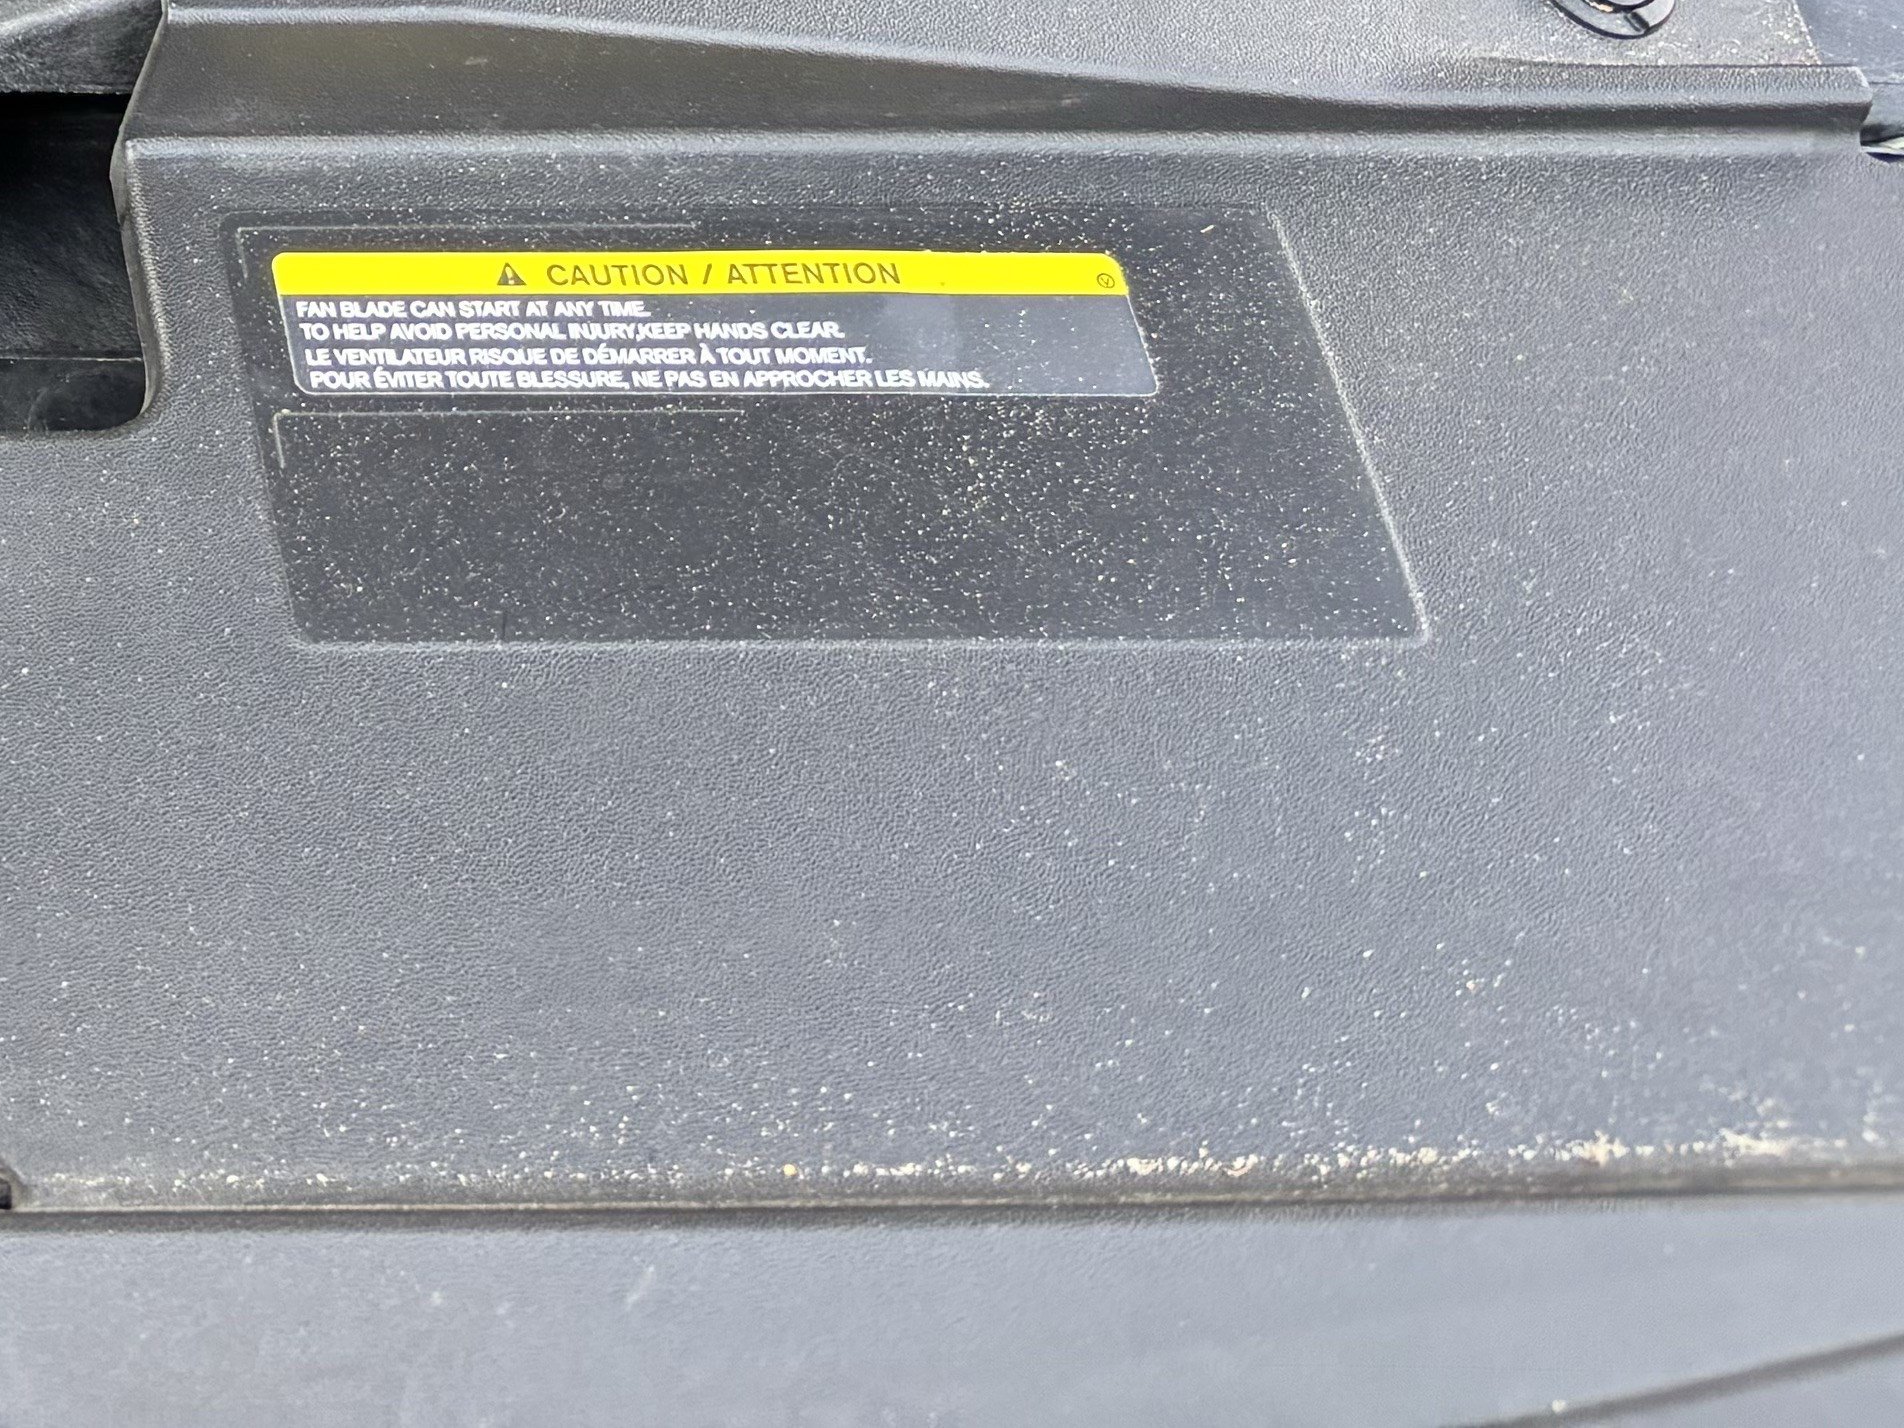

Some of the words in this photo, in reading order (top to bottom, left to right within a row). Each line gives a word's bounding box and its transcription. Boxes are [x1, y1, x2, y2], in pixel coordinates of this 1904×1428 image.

[546, 264, 689, 286] CAUTION
[727, 263, 901, 284] ATTENTION
[296, 301, 337, 318] FAN
[341, 301, 407, 318] BLADE
[410, 301, 455, 317] CAN
[459, 301, 521, 317] START
[525, 301, 548, 317] AT
[554, 301, 594, 317] ANY
[598, 300, 652, 317] TIME.
[299, 323, 329, 340] TO
[334, 323, 386, 340] HELP
[390, 323, 452, 340] AVOID
[455, 323, 567, 340] PERSONAL
[695, 321, 767, 339] HANDS
[770, 321, 845, 339] CLEAR.
[305, 349, 331, 366] LE
[334, 348, 467, 366] VENTILATEUR
[469, 348, 547, 366] RISQUE
[551, 348, 579, 365] DE
[583, 343, 696, 365] DÉMARRER
[699, 343, 716, 364] À
[717, 347, 772, 364] TOUT
[776, 346, 873, 364] MOMENT.
[310, 371, 370, 389] POUR
[373, 367, 443, 389] ÉVITER
[449, 371, 513, 389] TOUTE
[518, 371, 630, 390] BLESSURE,
[633, 371, 662, 388] NE
[664, 371, 707, 388] PAS
[710, 371, 740, 388] EN
[743, 370, 873, 389] APPROCHER
[876, 370, 915, 387] LES
[917, 370, 990, 389] MAINS.
